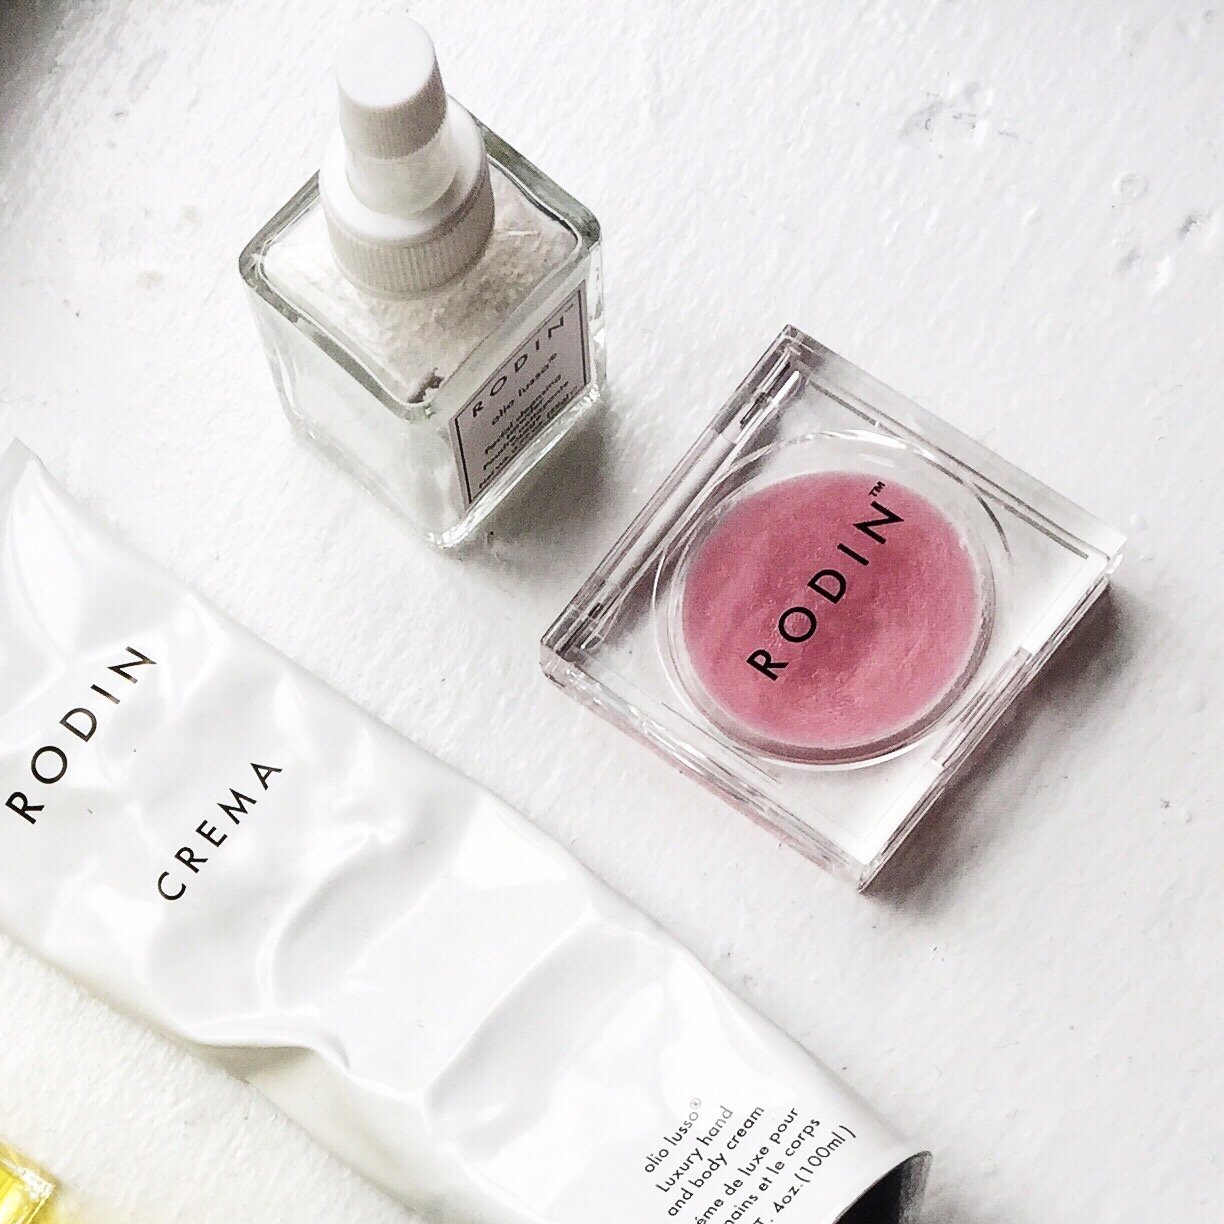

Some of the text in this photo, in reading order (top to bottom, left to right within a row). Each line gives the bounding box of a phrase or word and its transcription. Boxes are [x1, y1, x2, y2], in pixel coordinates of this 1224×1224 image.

[492, 400, 514, 425] olio
[5, 646, 157, 825] RODIN
[157, 762, 283, 900] CREMA
[644, 1148, 669, 1174] olio
[655, 1104, 733, 1192] Luxury hand
[668, 1106, 765, 1217] and body cream
[724, 1178, 743, 1197] de
[737, 1146, 770, 1176] luxe
[769, 1107, 799, 1145] pour
[758, 1176, 773, 1191] et
[766, 1160, 786, 1175] le
[785, 1118, 820, 1157] corps
